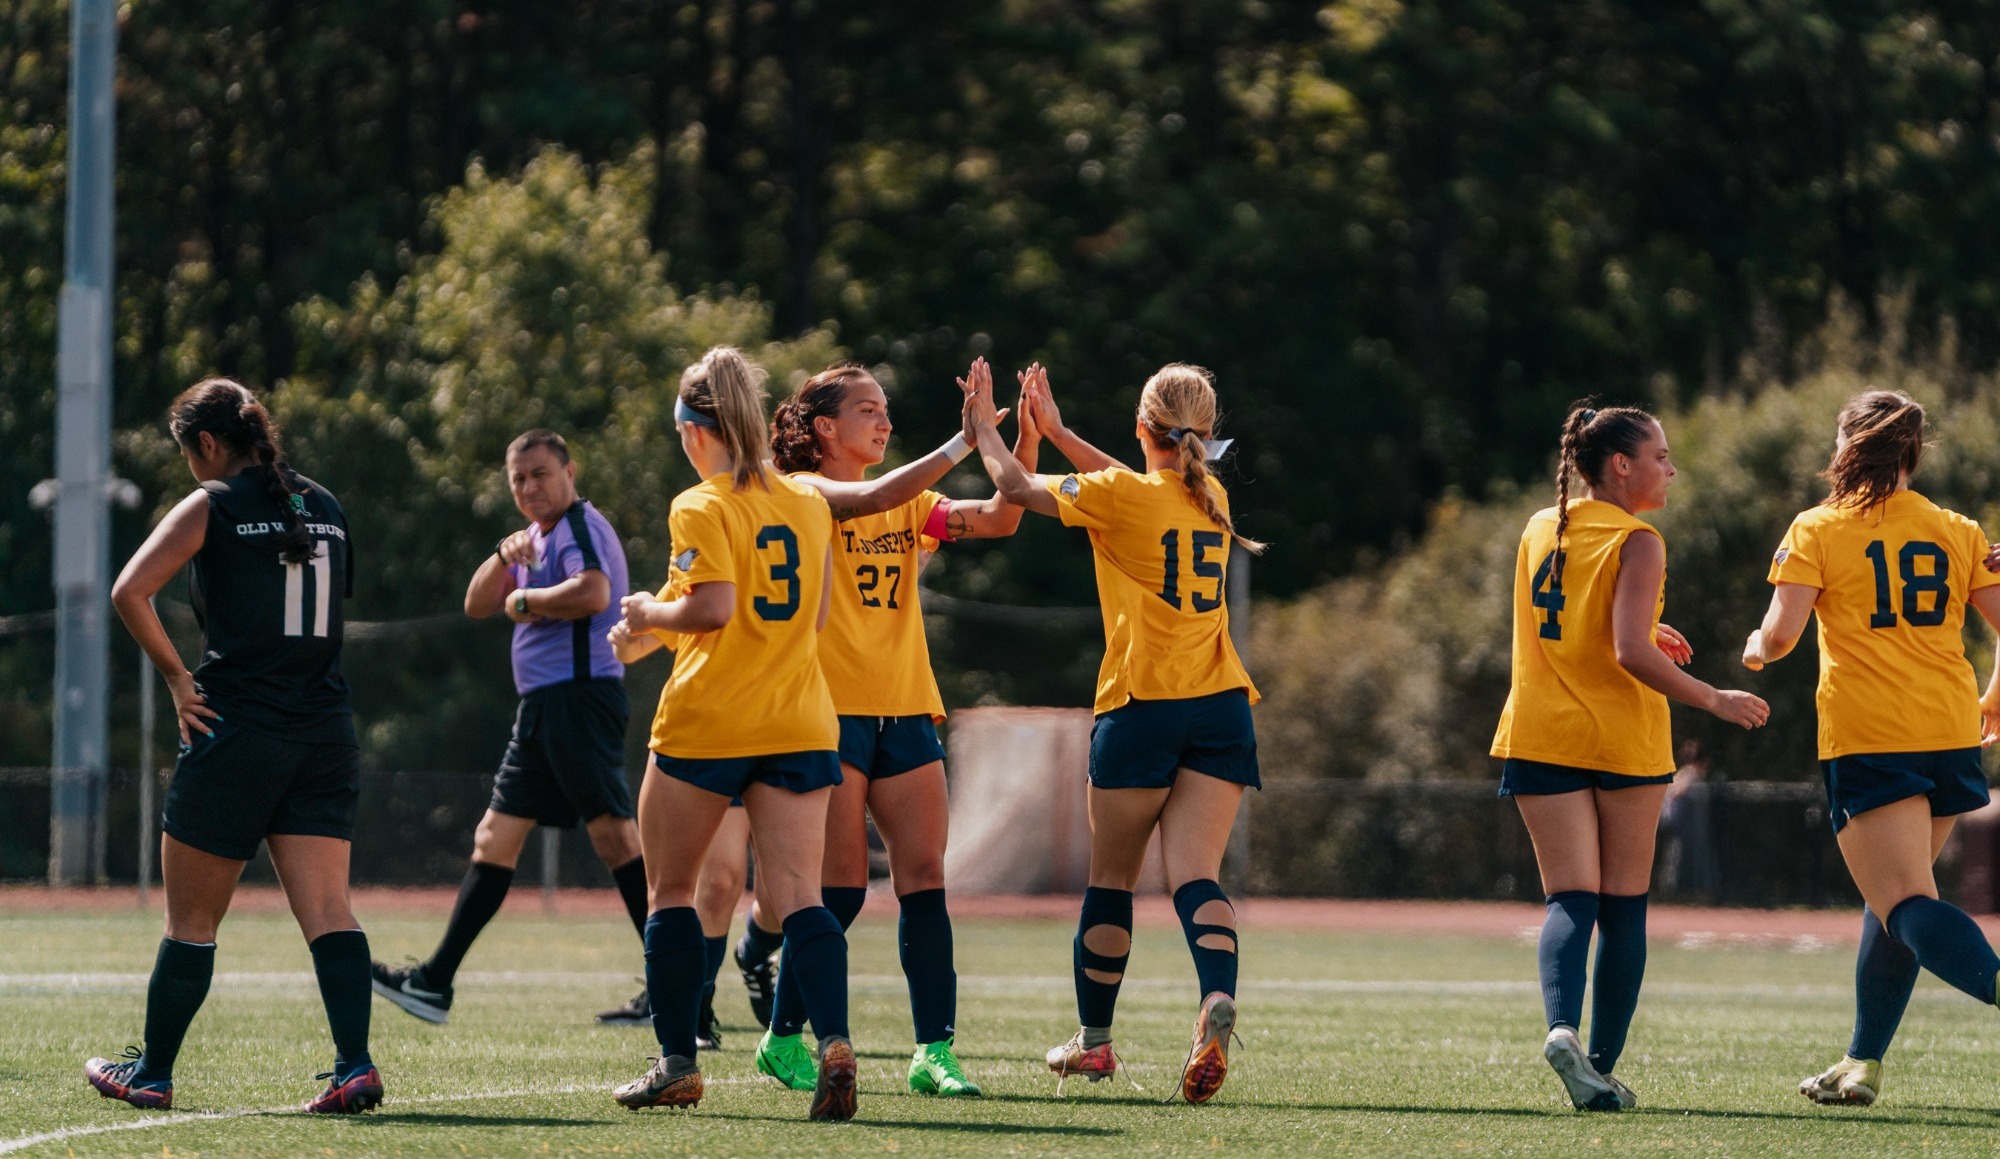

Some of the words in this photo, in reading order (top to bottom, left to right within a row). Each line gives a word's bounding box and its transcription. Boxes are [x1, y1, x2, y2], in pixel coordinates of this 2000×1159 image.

[236, 522, 270, 536] OLD
[841, 530, 860, 553] T.
[1156, 528, 1224, 613] 15
[278, 540, 331, 637] 11
[753, 524, 800, 621] 3
[856, 564, 901, 609] 27
[1531, 550, 1567, 641] 4
[1865, 540, 1950, 628] 18
